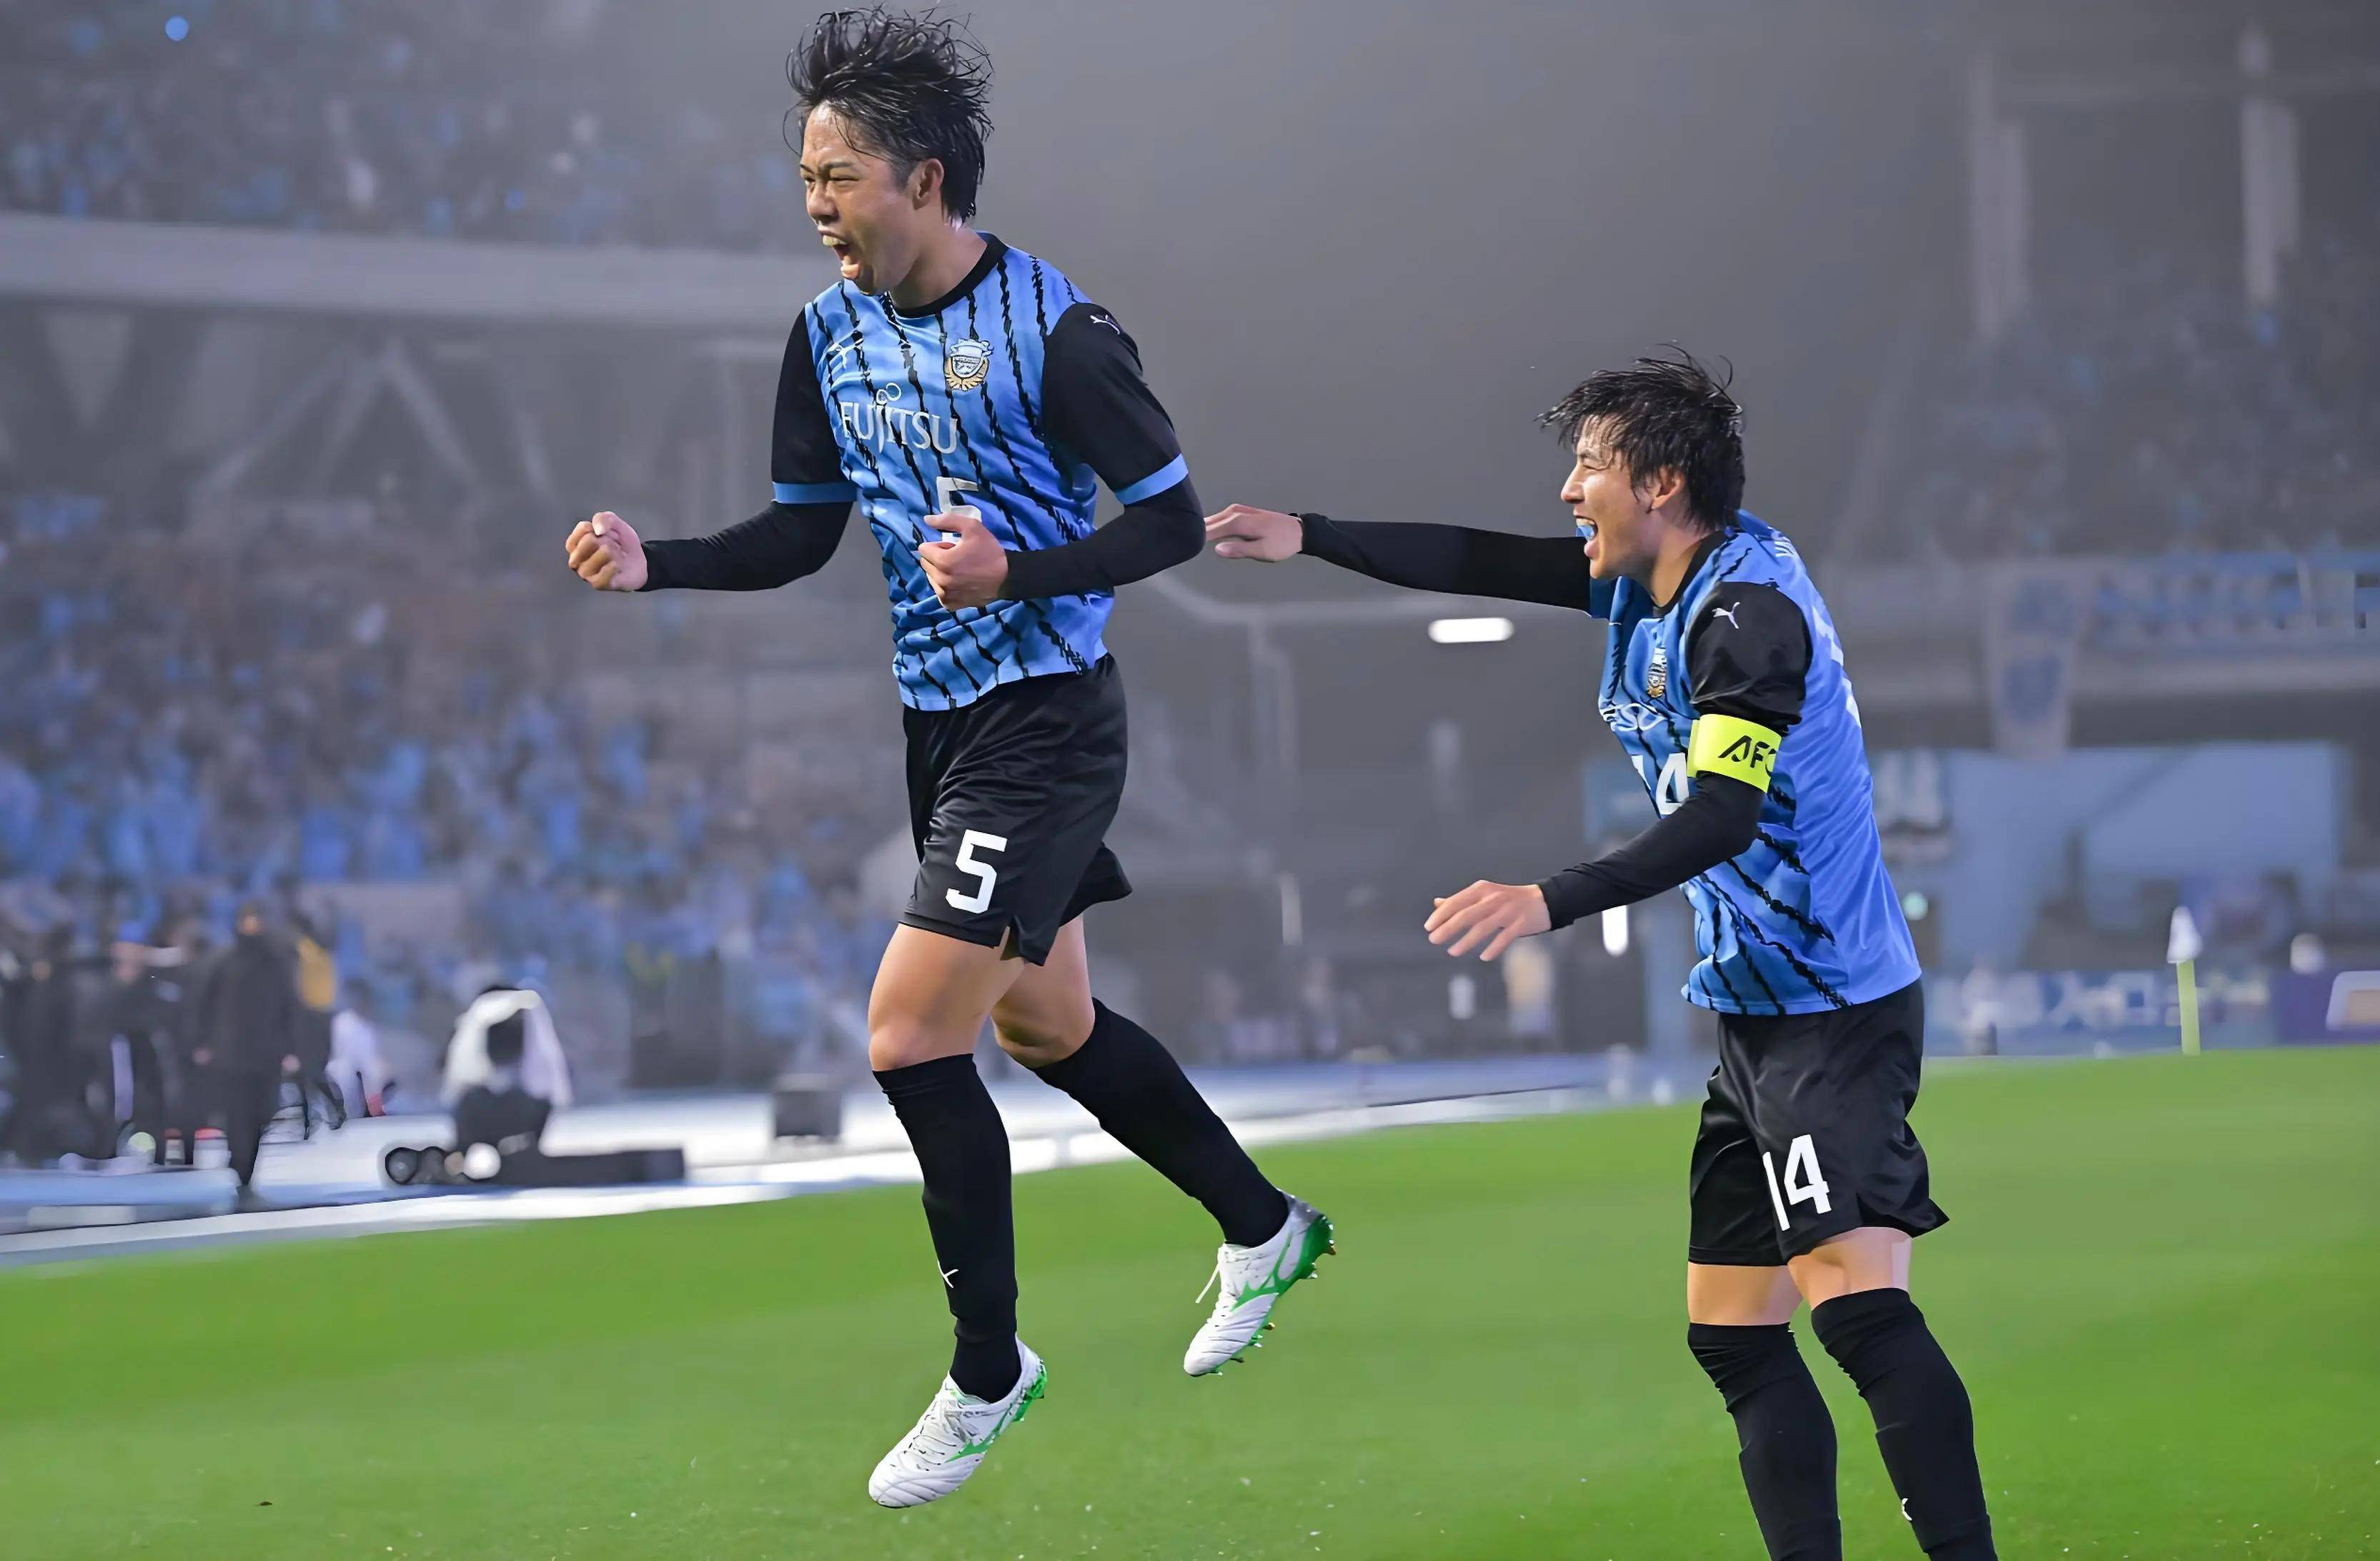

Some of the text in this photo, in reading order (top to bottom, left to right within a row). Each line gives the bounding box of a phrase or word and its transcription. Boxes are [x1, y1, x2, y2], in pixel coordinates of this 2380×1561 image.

[840, 401, 958, 454] FUJITSU
[945, 829, 1008, 914] 5
[1762, 1134, 1832, 1232] 14
